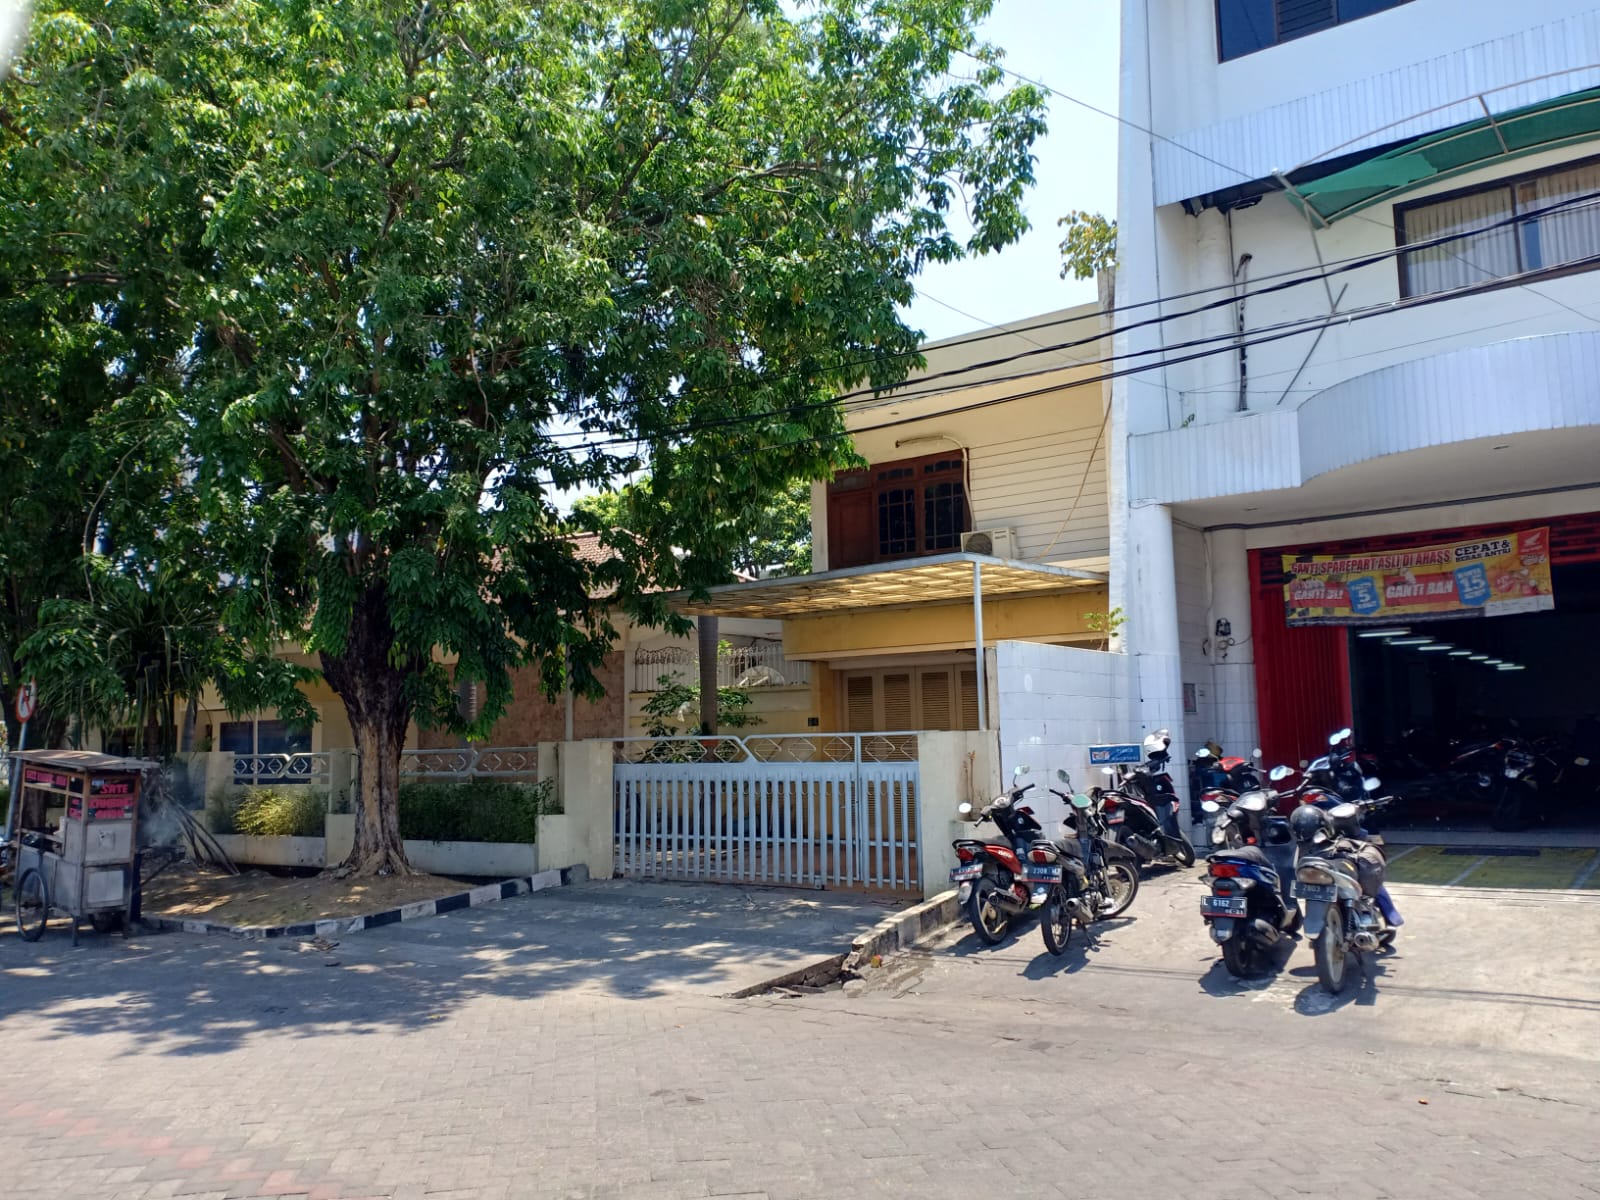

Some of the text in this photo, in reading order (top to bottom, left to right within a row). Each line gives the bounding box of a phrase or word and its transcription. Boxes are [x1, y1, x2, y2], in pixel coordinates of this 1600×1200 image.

[1291, 549, 1450, 575] GANTI SPAREPART ASLI DI AHASS
[1386, 583, 1425, 599] GANTI
[1426, 580, 1454, 595] BAN
[1460, 576, 1485, 593] 15
[1359, 588, 1371, 603] 5
[1203, 897, 1209, 906] L
